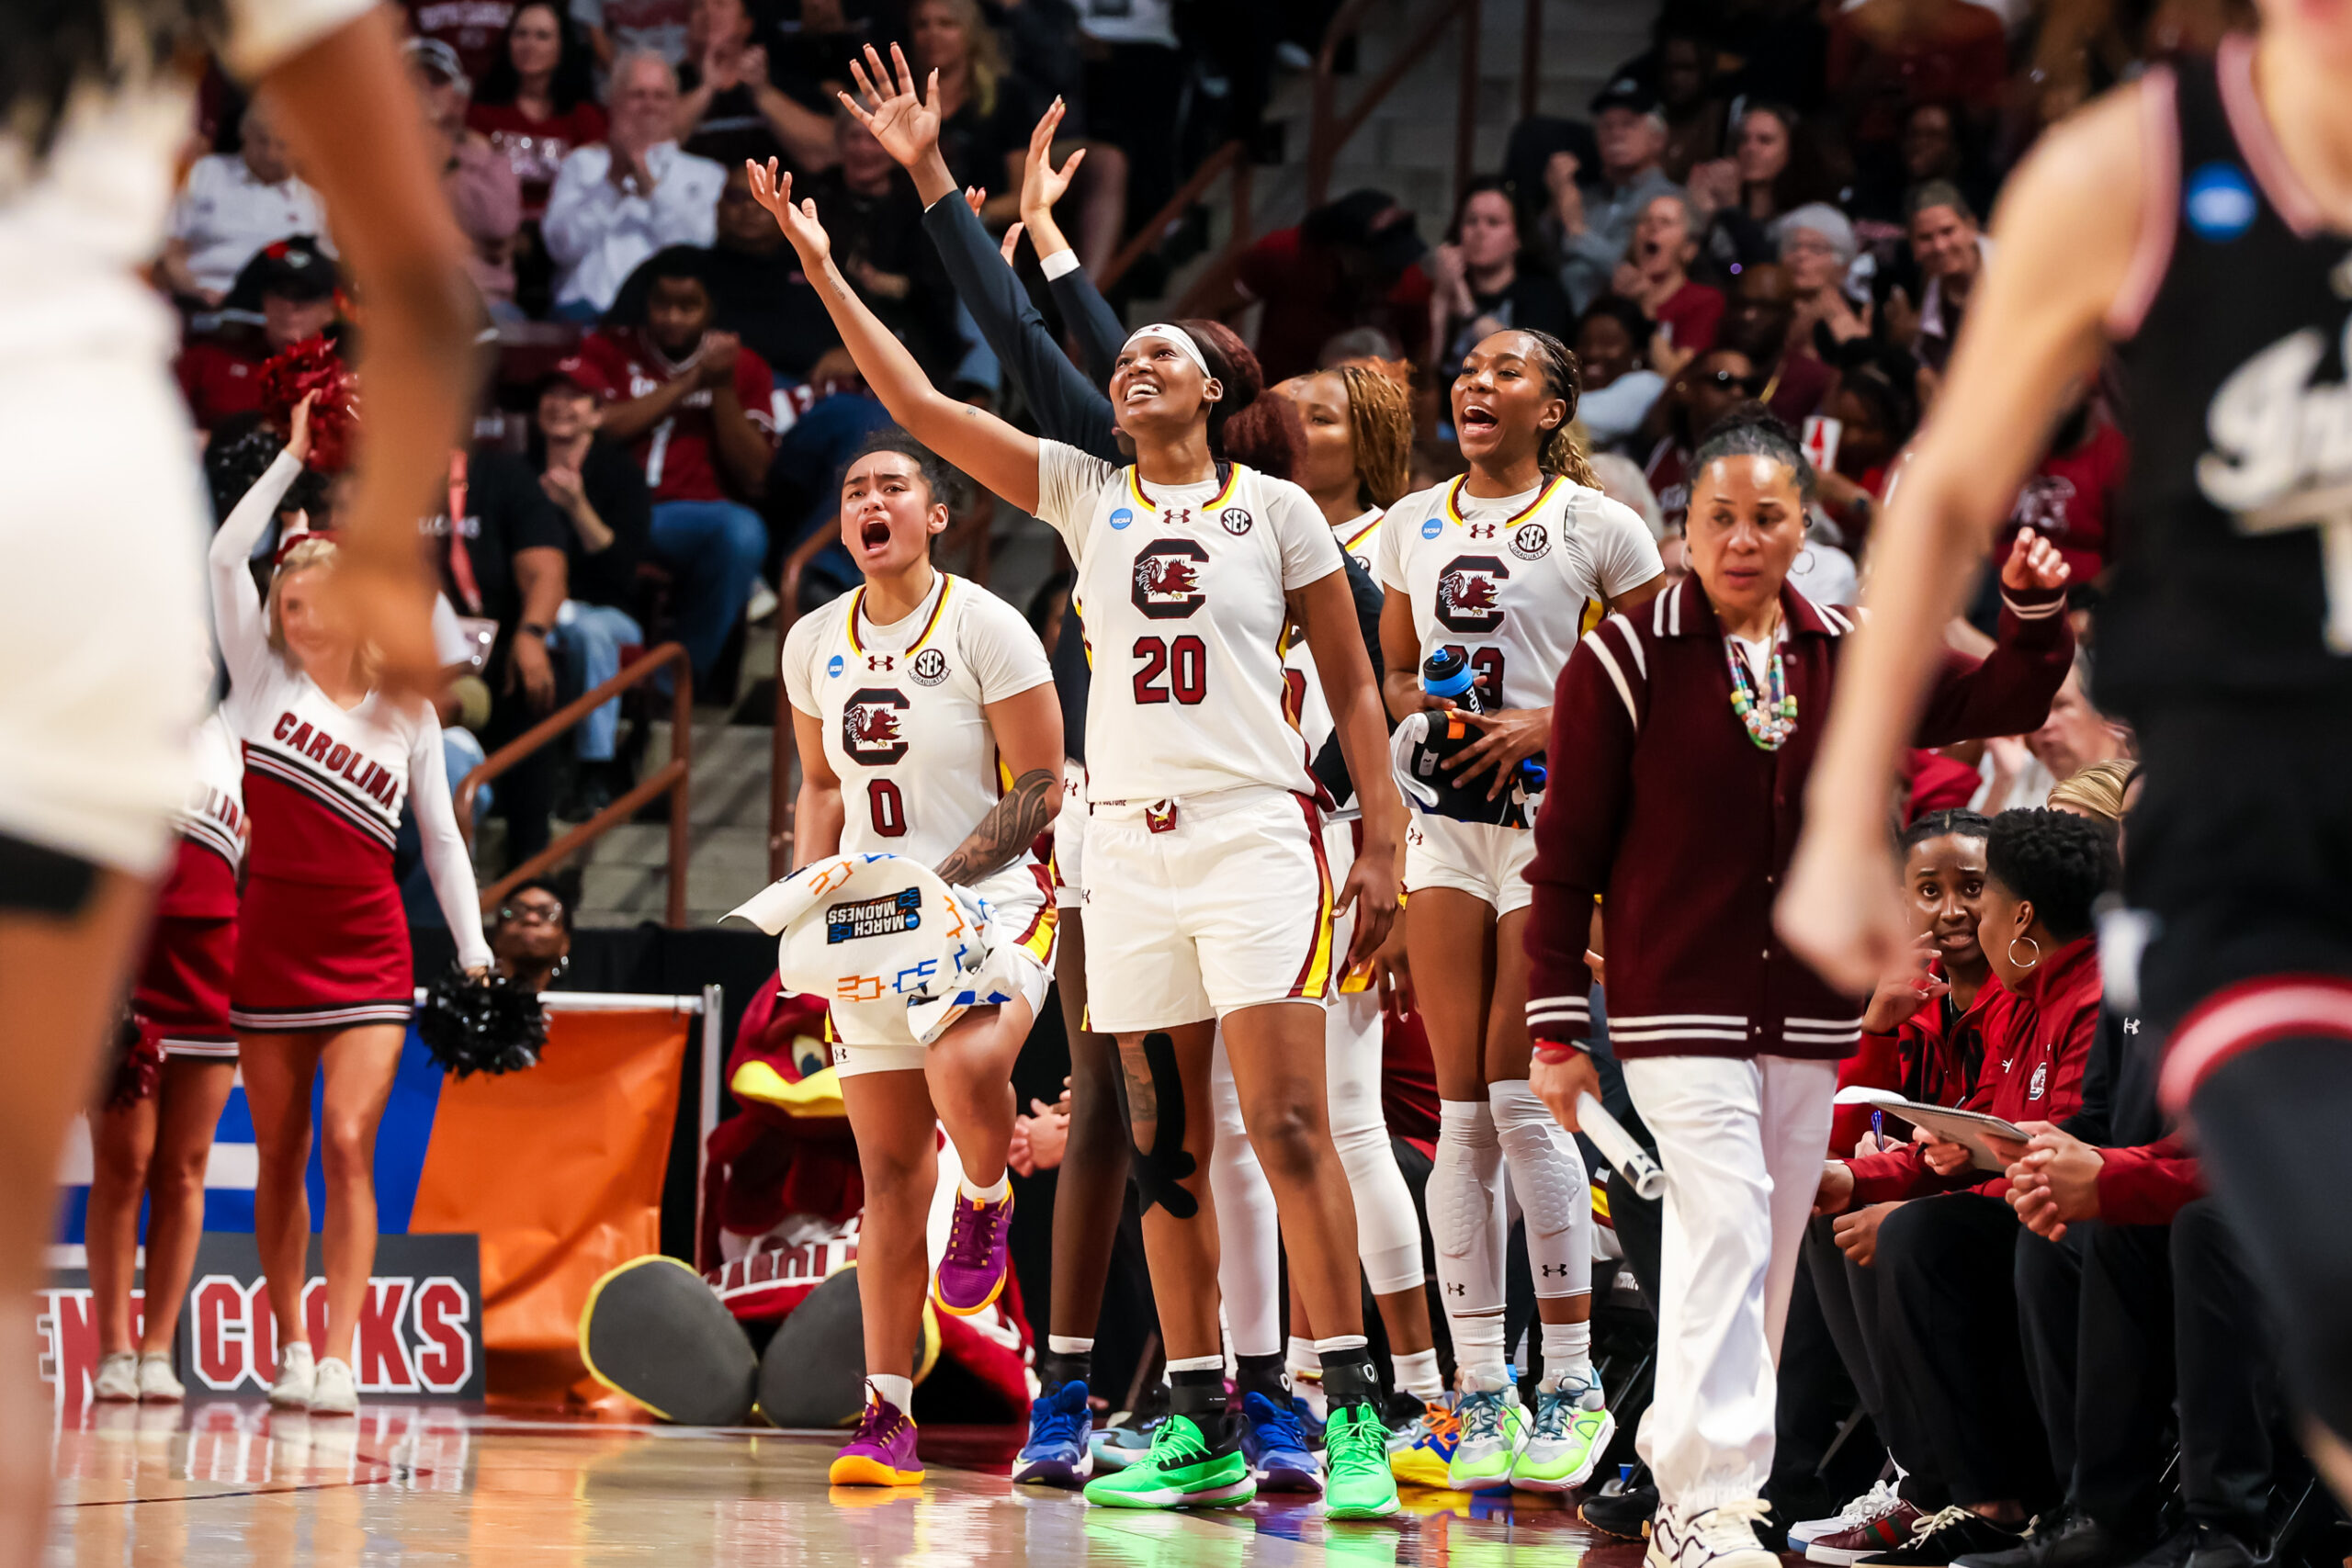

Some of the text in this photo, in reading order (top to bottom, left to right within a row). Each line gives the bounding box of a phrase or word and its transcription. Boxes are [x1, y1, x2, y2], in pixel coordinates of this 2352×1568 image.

[1222, 507, 1252, 535] SEC
[1519, 524, 1545, 551] SEC
[1511, 547, 1545, 559] GRADUATE
[917, 649, 943, 677] SEC
[1132, 635, 1207, 705] 20
[1442, 644, 1506, 710] 3
[911, 673, 945, 686] GRADUATE
[273, 712, 399, 810] CAROLINA
[867, 779, 907, 838] 0
[828, 900, 897, 924] MADNESS
[854, 914, 905, 937] MARCH
